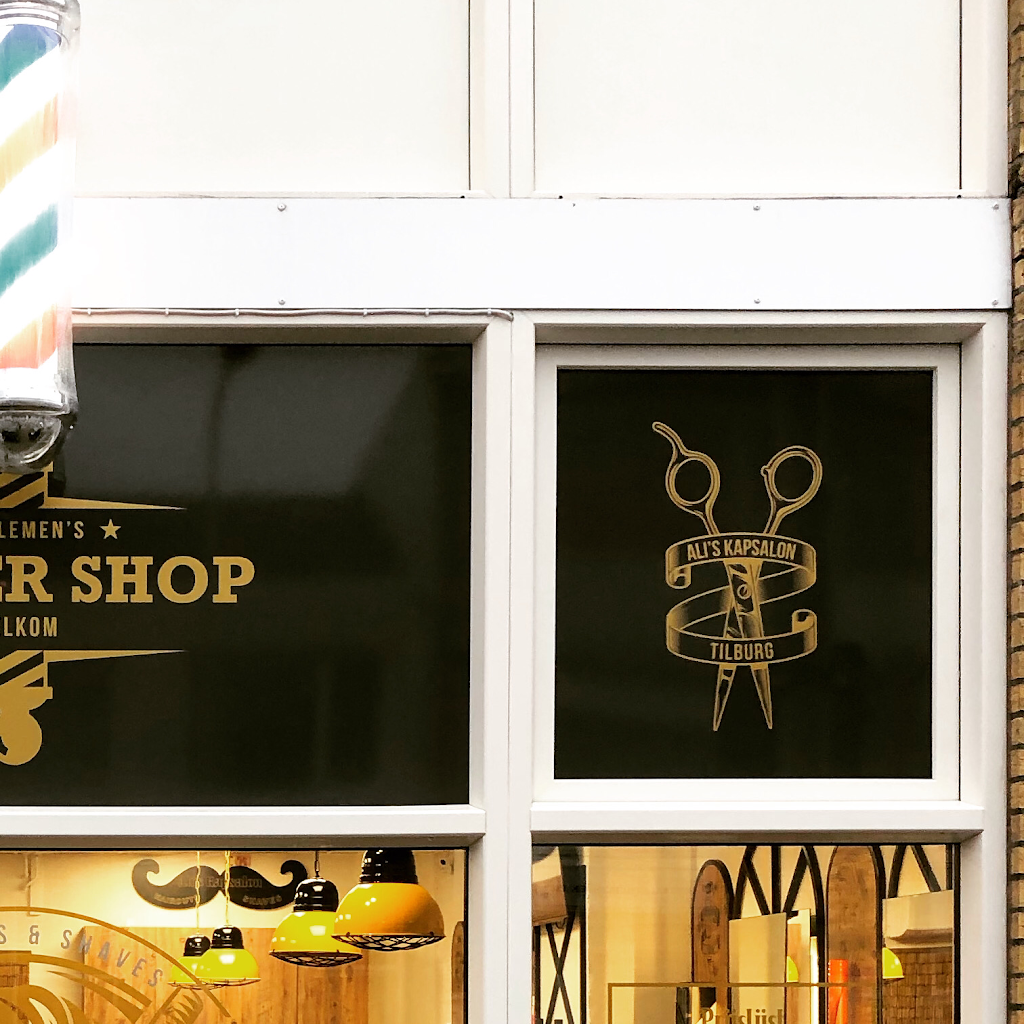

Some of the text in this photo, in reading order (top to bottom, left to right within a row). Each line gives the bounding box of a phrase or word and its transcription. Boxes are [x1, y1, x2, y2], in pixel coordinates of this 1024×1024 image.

[687, 539, 797, 561] ALI'S KAPSALON
[71, 555, 255, 604] SHOP
[710, 642, 774, 661] TILBURG
[29, 925, 40, 944] &
[60, 929, 163, 988] SHAVES
